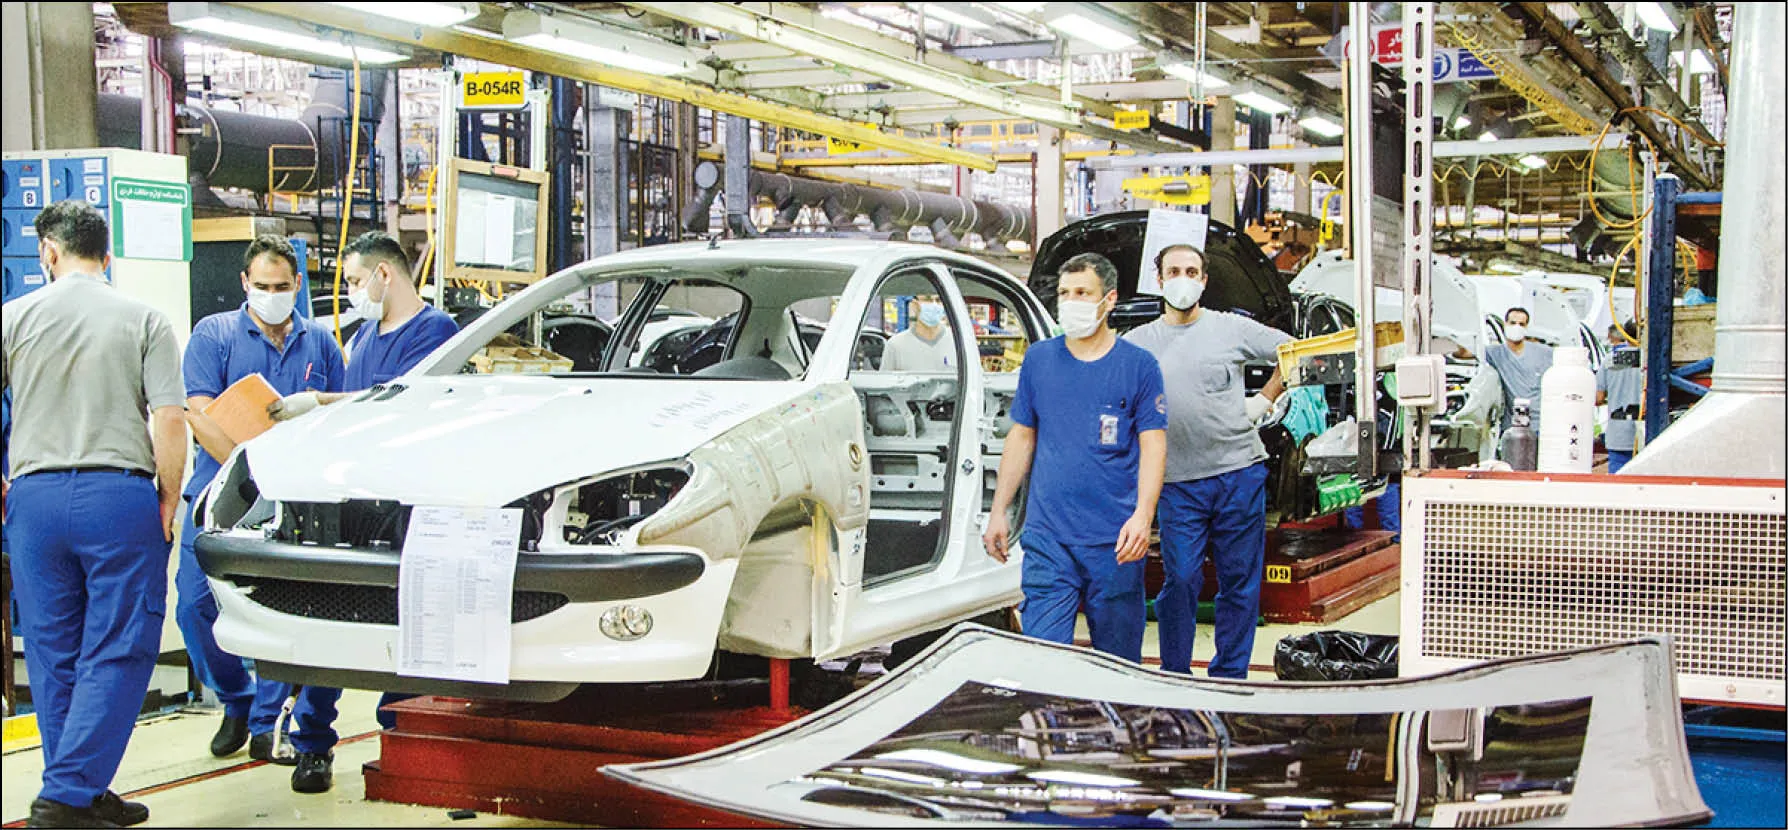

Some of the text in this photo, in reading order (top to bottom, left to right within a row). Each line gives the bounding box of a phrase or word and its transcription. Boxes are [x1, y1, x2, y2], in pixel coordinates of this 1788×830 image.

[467, 81, 520, 96] B-054R
[26, 192, 34, 204] B
[89, 189, 97, 201] C
[1269, 567, 1289, 580] 09
